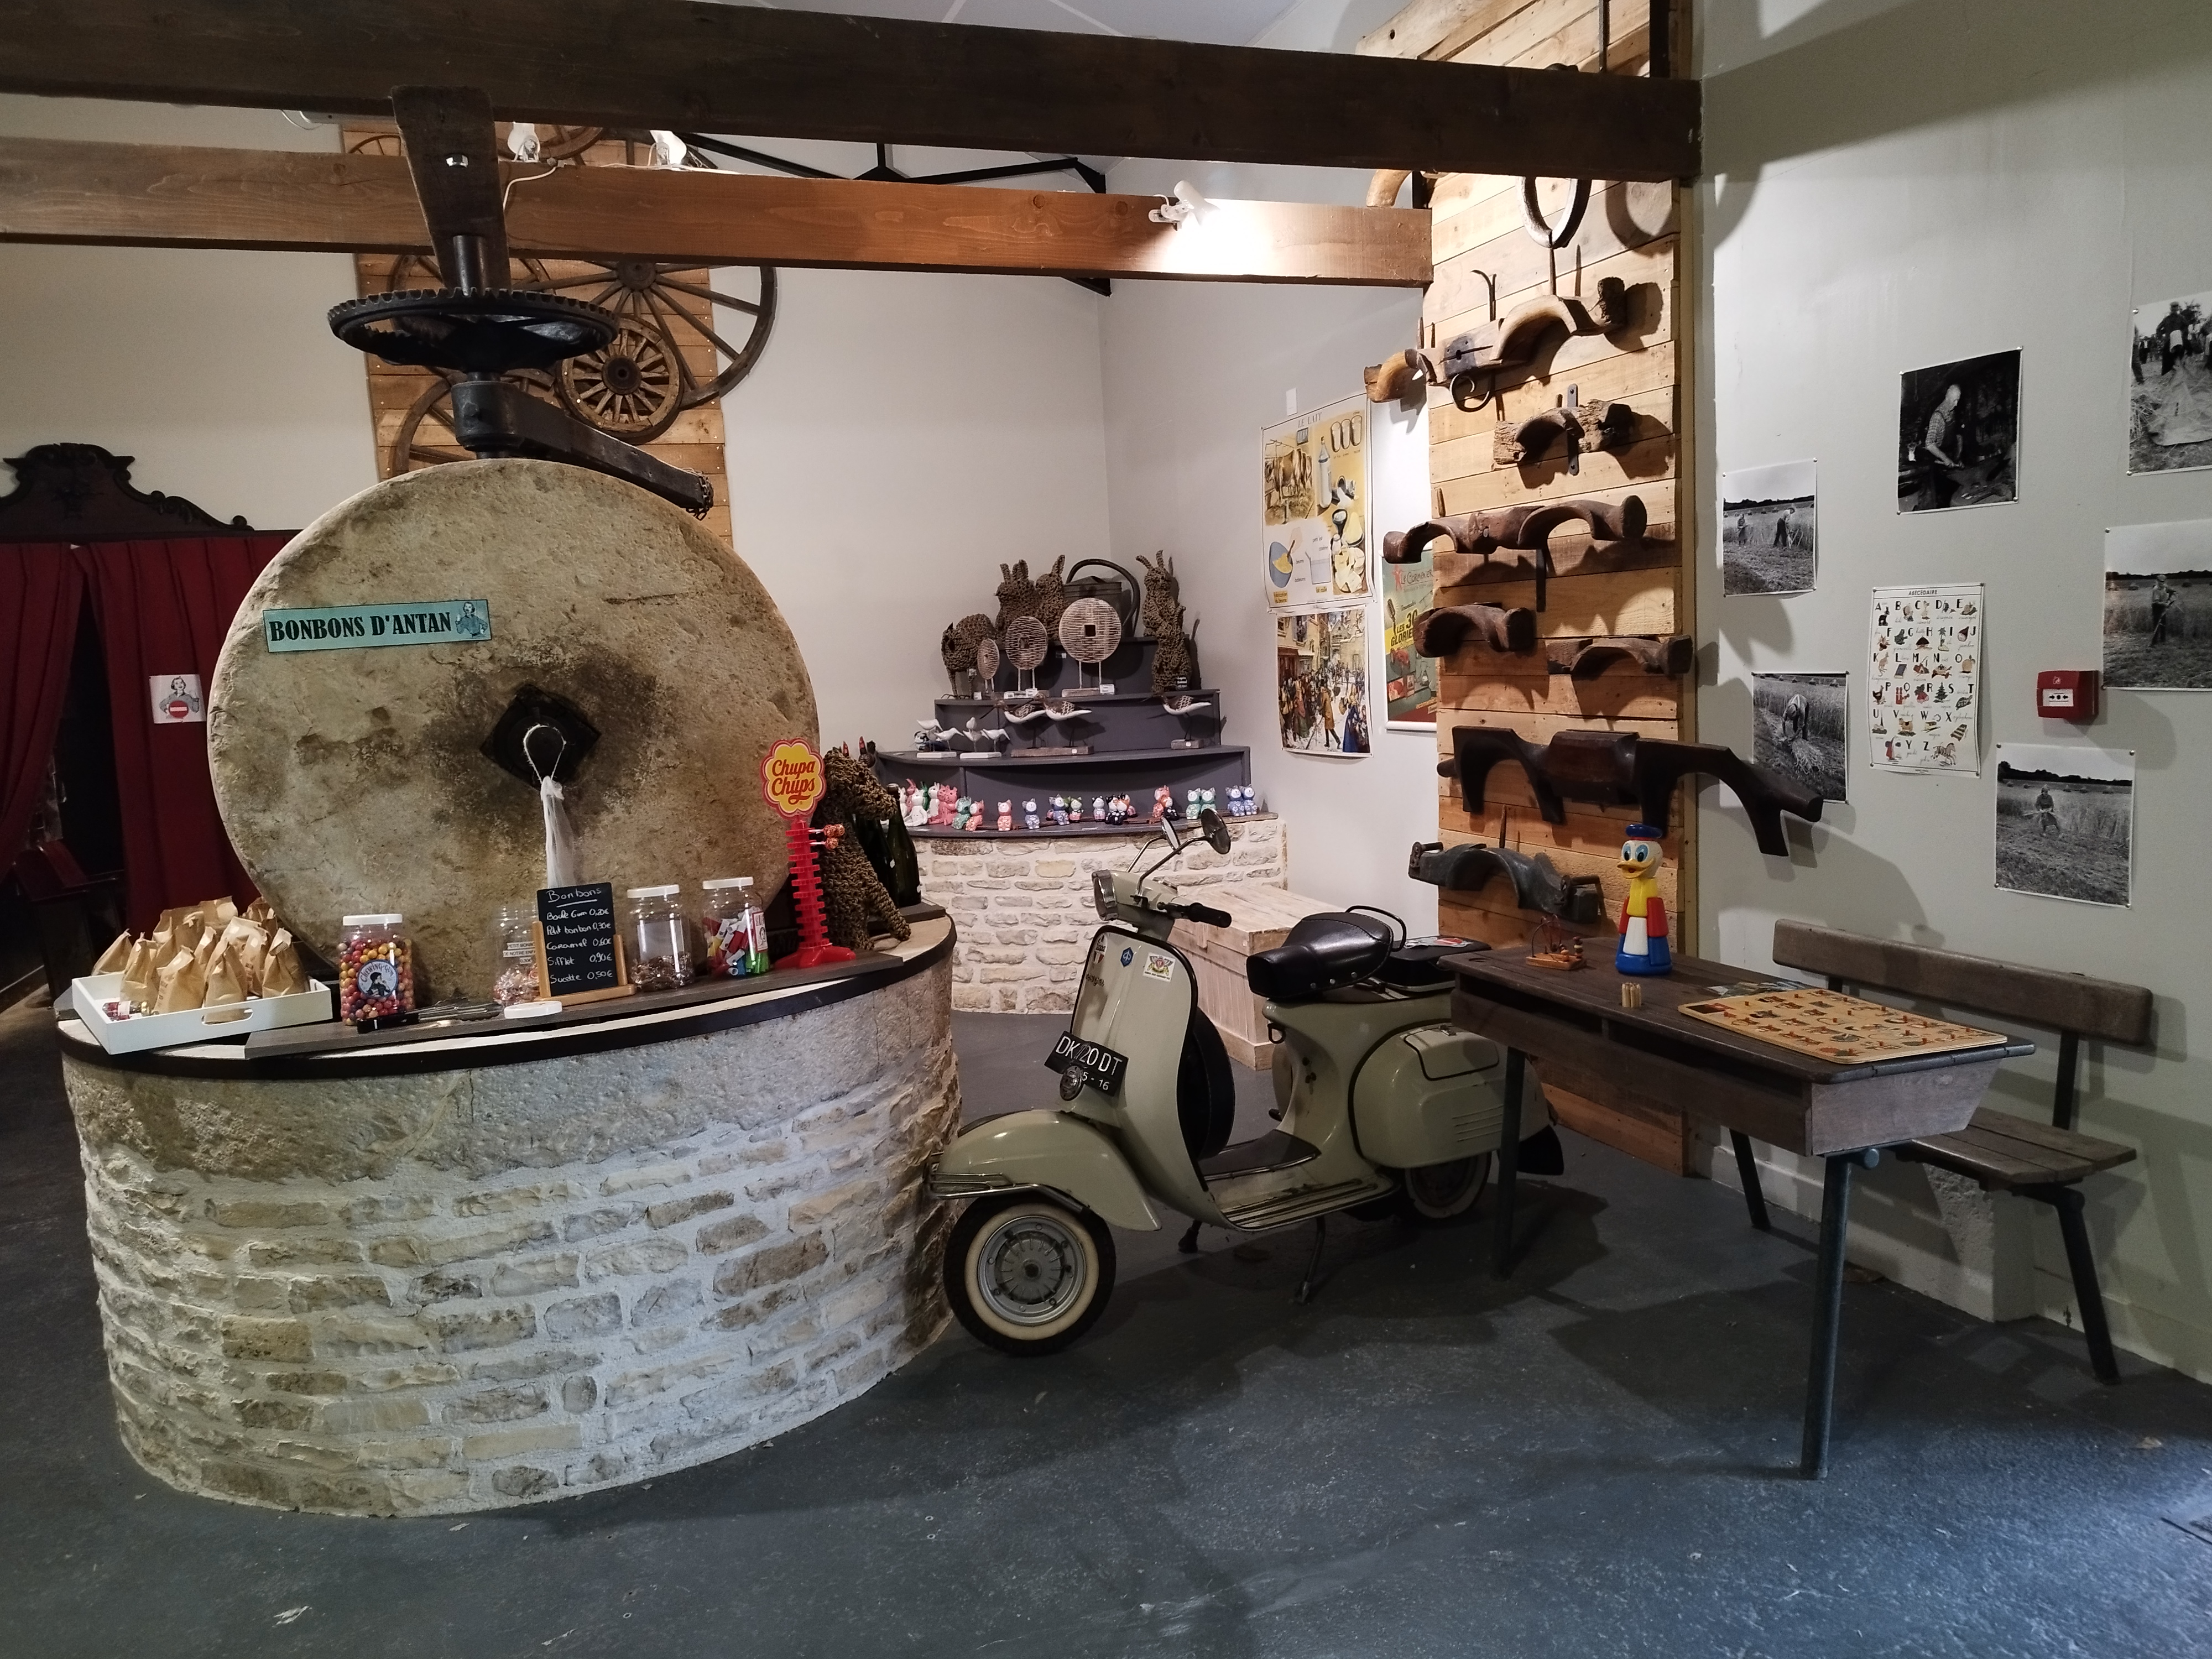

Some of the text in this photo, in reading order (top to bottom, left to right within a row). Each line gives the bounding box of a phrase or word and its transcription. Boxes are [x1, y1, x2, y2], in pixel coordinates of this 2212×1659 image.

[1307, 412, 1322, 425] LAIT
[1875, 598, 1964, 611] A B C D E
[269, 612, 451, 642] BONBONS D'ANTAN
[1887, 627, 1893, 637] F
[1908, 627, 1913, 637] G
[1926, 627, 1933, 637] H
[1949, 626, 1953, 636] I
[1970, 625, 1976, 636] J
[1391, 628, 1413, 646] GLORIE
[1873, 653, 1879, 662] K
[1895, 653, 1902, 662] L
[1913, 653, 1919, 662] M
[1933, 653, 1940, 662] N
[1955, 654, 1962, 663] O
[1885, 682, 1974, 693] P Q R S T
[1873, 709, 1879, 718] U
[1893, 709, 1899, 718] V
[1921, 711, 1928, 720] W
[1945, 712, 1952, 722] X
[1905, 740, 1929, 751] Y Z
[772, 759, 816, 779] Chupa
[771, 776, 815, 805] Chups
[545, 887, 602, 902] Bonbons
[1055, 1036, 1081, 1060] DK
[1098, 1052, 1123, 1076] DT
[1098, 1079, 1110, 1091] 16
